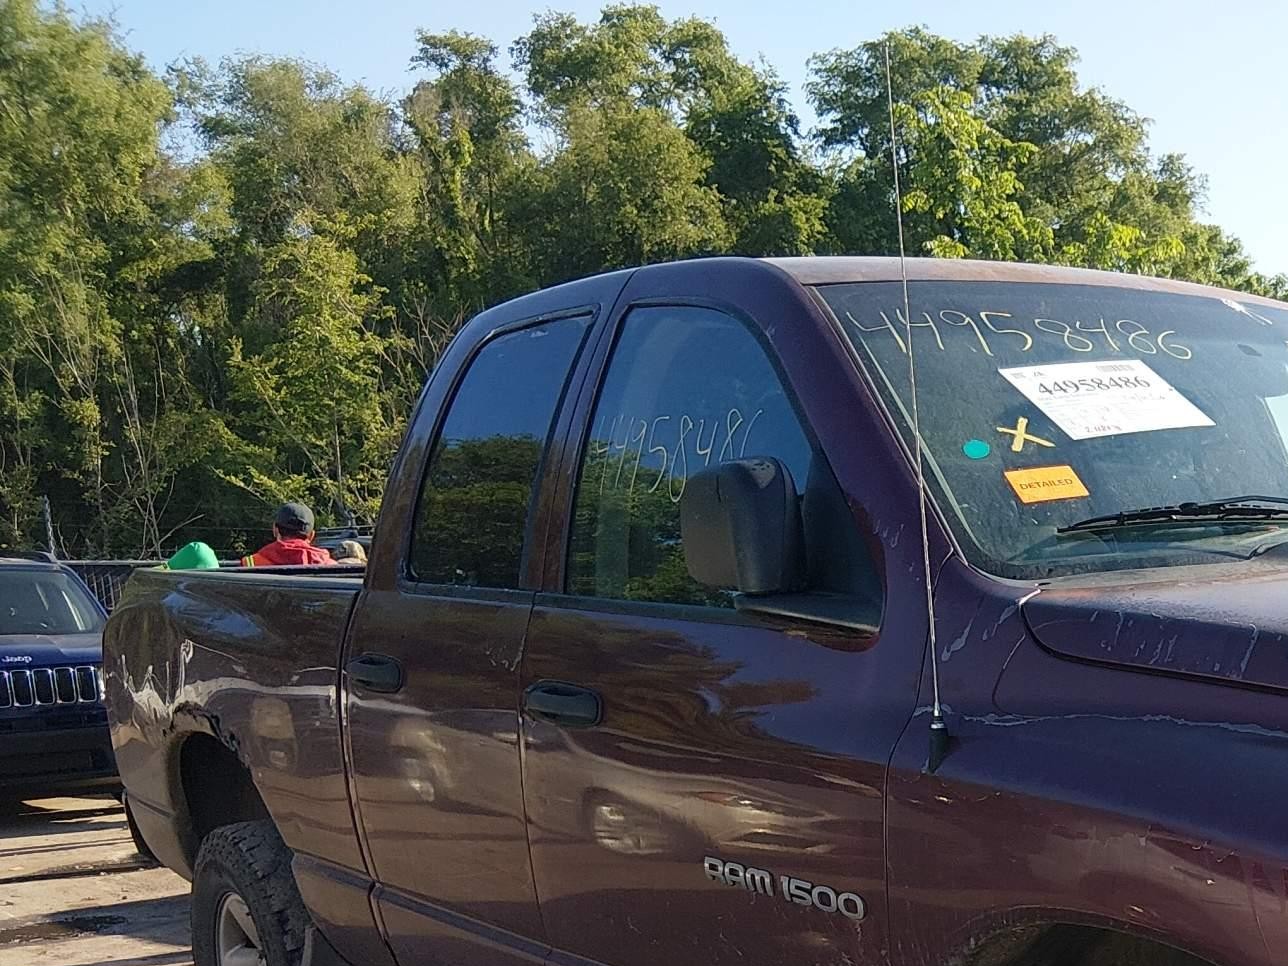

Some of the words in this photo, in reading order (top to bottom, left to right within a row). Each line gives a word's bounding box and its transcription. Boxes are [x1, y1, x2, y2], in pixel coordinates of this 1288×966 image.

[846, 308, 1193, 360] 44958486
[1038, 375, 1151, 396] 44958486
[1019, 478, 1073, 490] DETAILED
[704, 856, 775, 897] RAM
[780, 875, 865, 920] 1500
